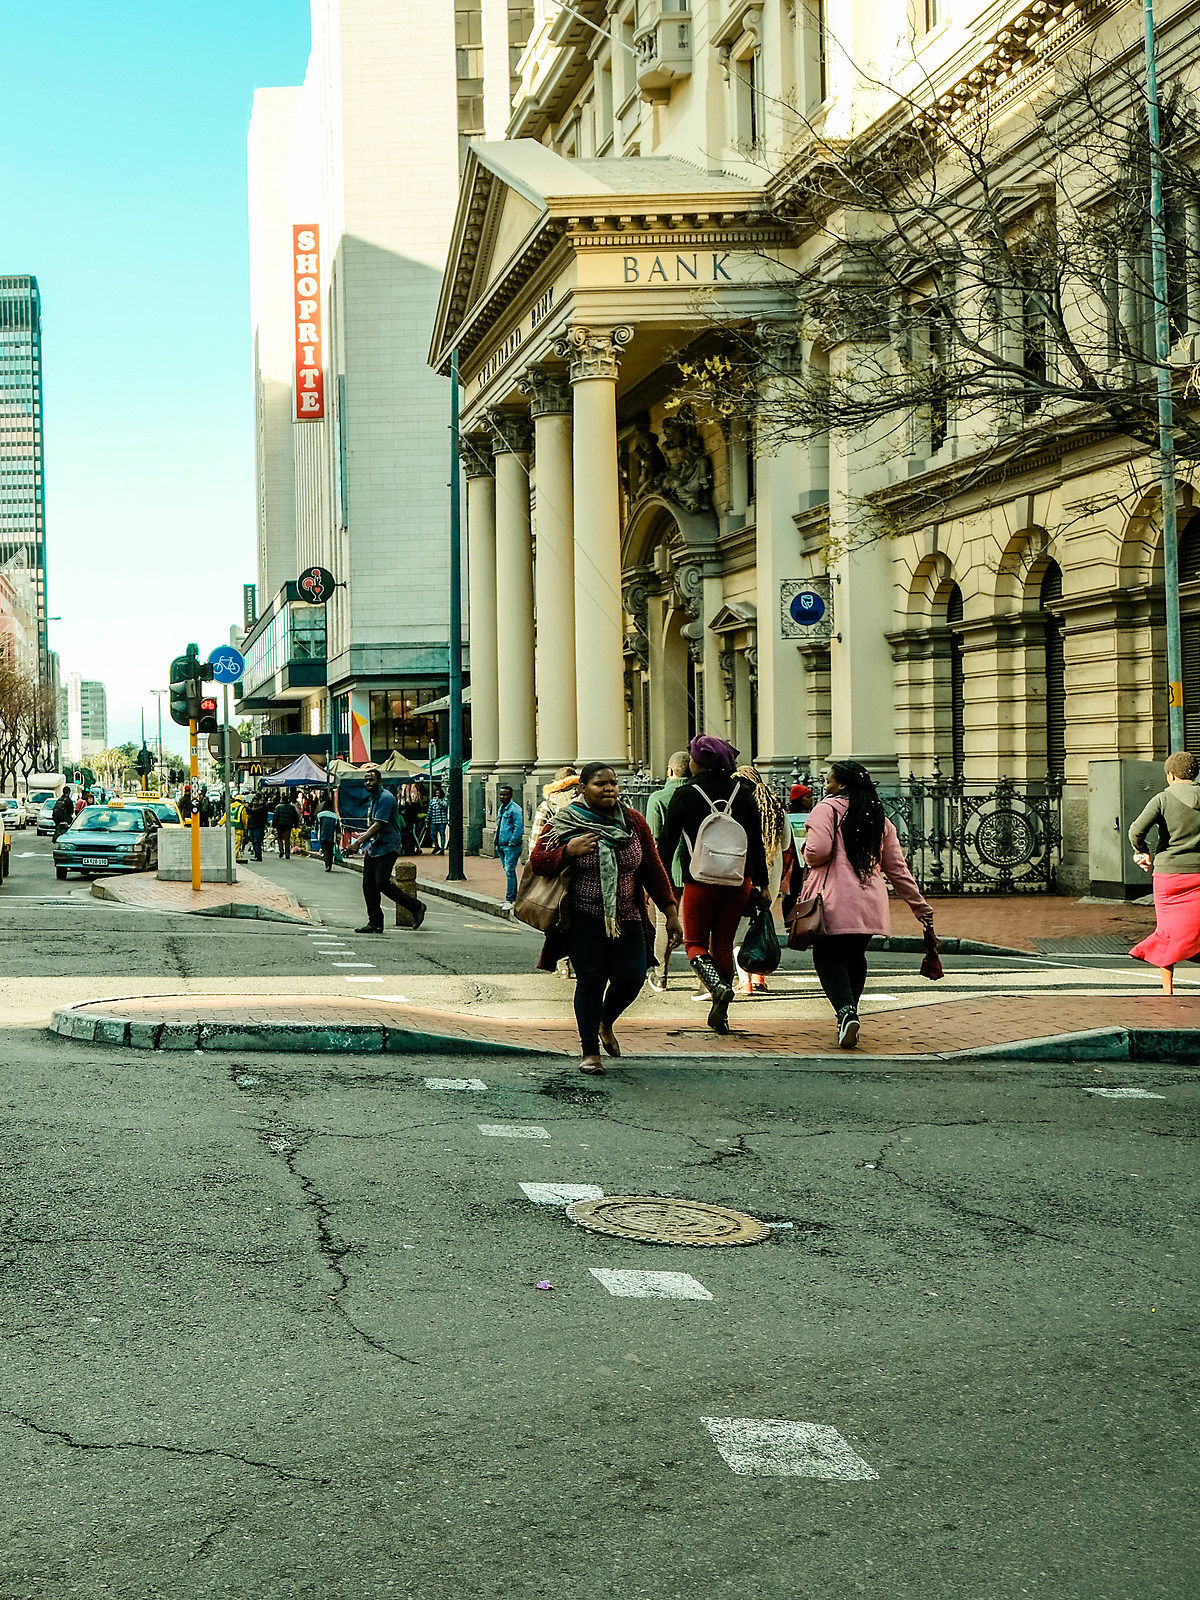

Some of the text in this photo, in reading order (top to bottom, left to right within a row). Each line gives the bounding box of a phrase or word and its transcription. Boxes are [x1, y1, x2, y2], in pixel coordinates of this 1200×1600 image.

[623, 254, 732, 283] BANK
[295, 231, 320, 412] SHOPRITE
[477, 286, 554, 389] STANDARD BANK
